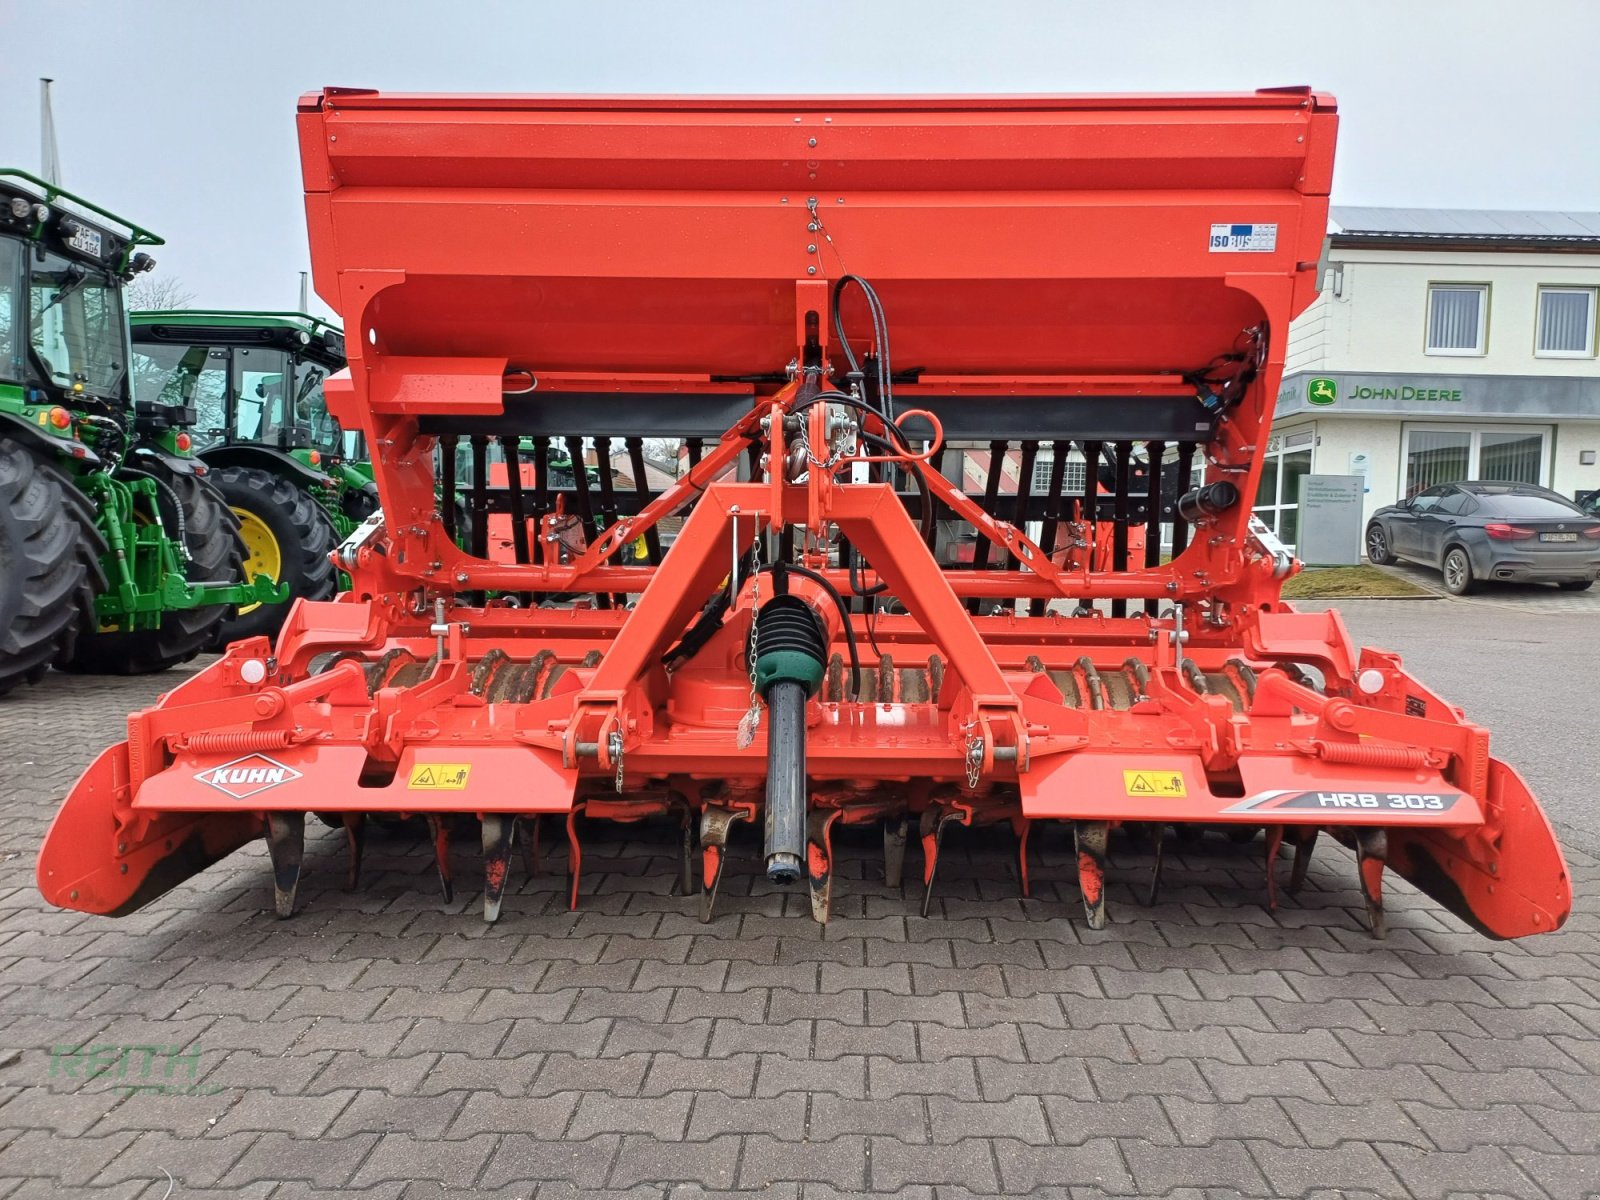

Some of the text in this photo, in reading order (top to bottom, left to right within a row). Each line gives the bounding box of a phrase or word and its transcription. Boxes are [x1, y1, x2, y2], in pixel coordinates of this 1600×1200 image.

[1348, 385, 1462, 402] JOHN DEERE
[211, 768, 285, 784] KUHN
[1317, 792, 1443, 810] HRB 303
